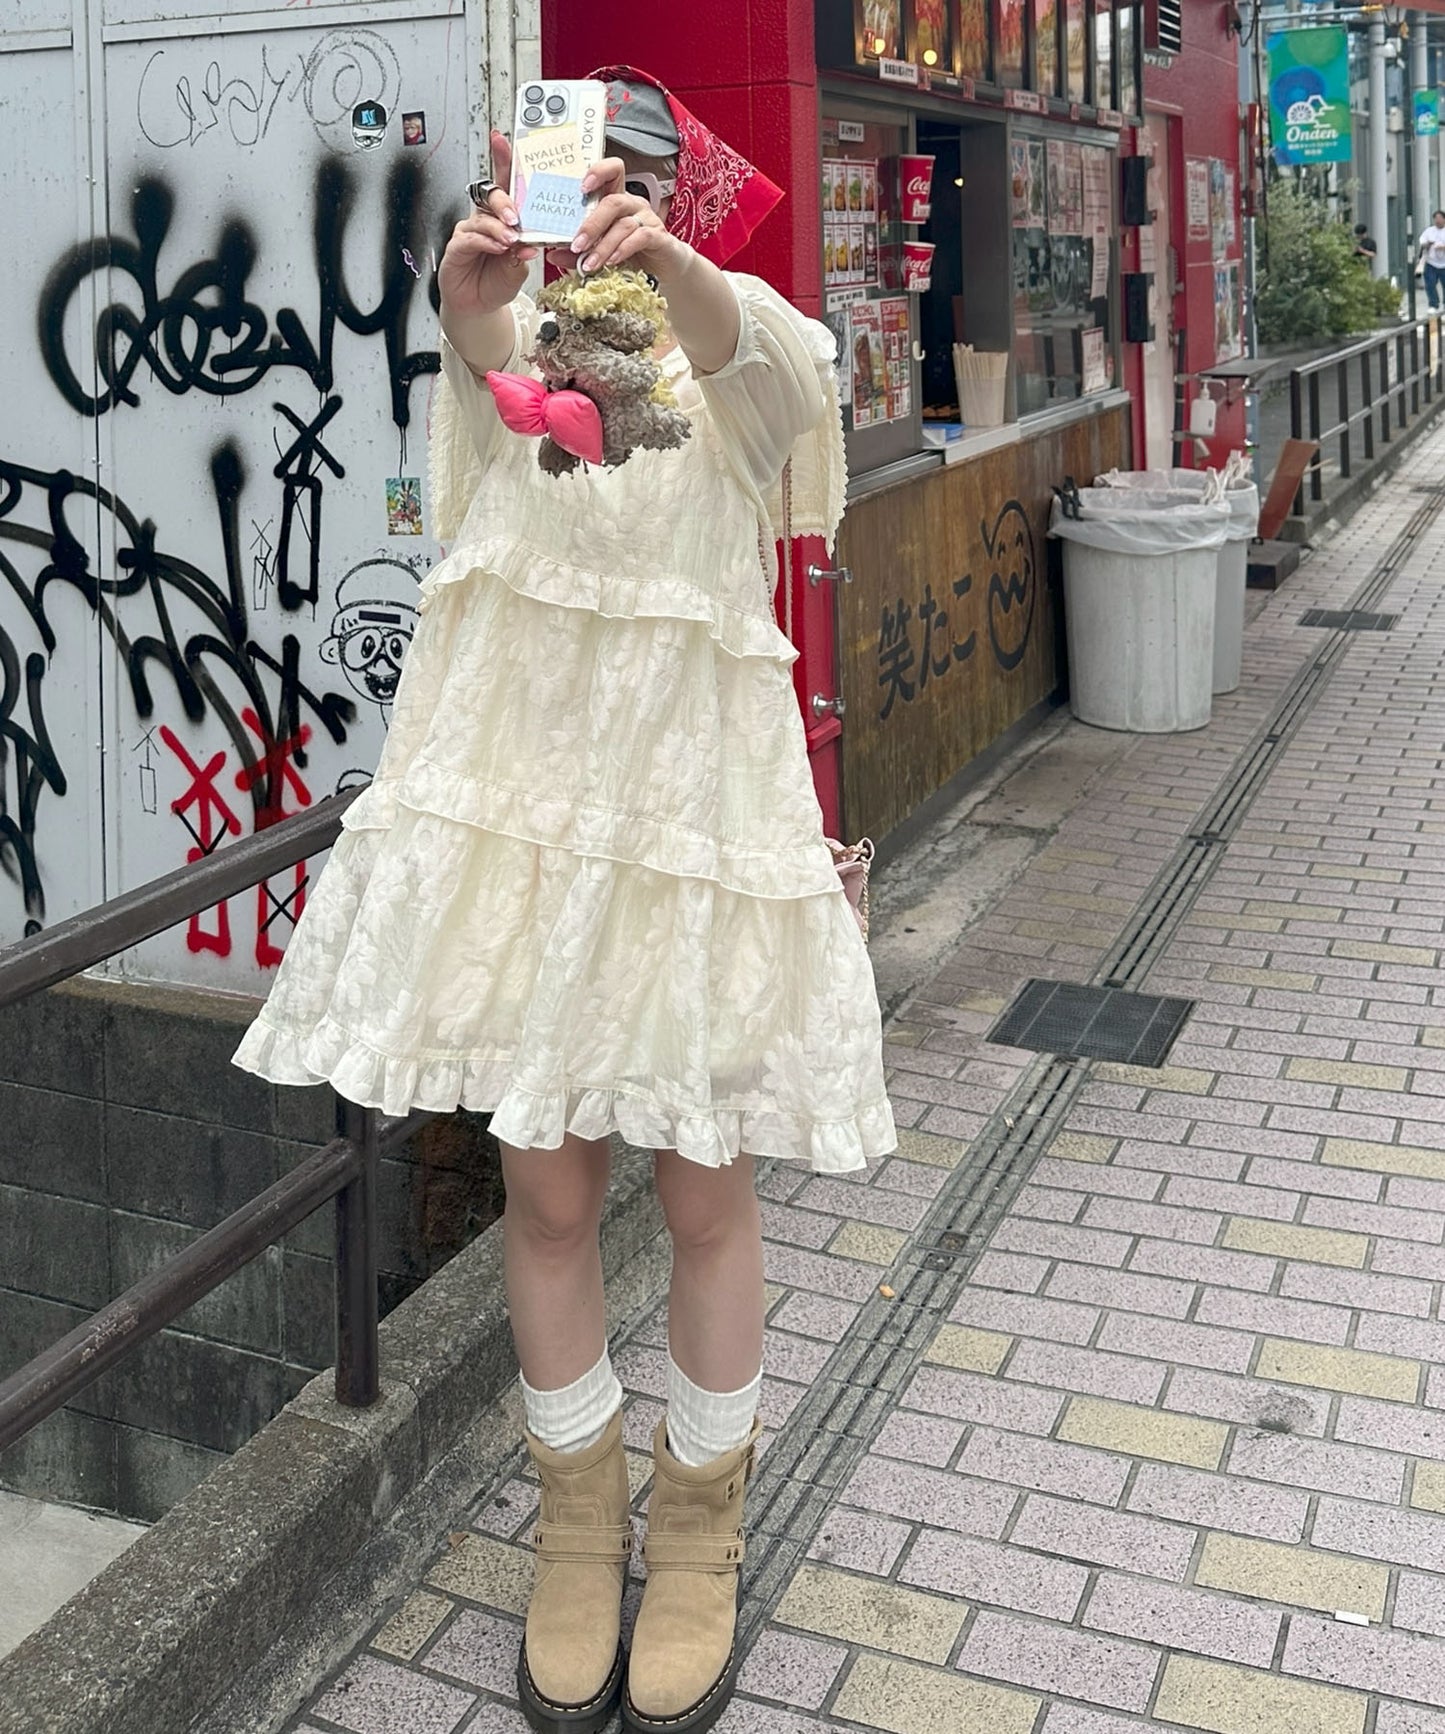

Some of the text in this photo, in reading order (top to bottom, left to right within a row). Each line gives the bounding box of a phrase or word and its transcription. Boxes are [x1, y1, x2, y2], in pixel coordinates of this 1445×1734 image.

[581, 107, 596, 151] TOKYO
[1286, 125, 1338, 142] Onden
[524, 142, 574, 163] NYALLEY
[531, 154, 575, 173] TOKYO
[536, 191, 575, 204] ALLEY
[530, 202, 576, 217] HAKATA
[878, 573, 978, 721] 笑たこ
